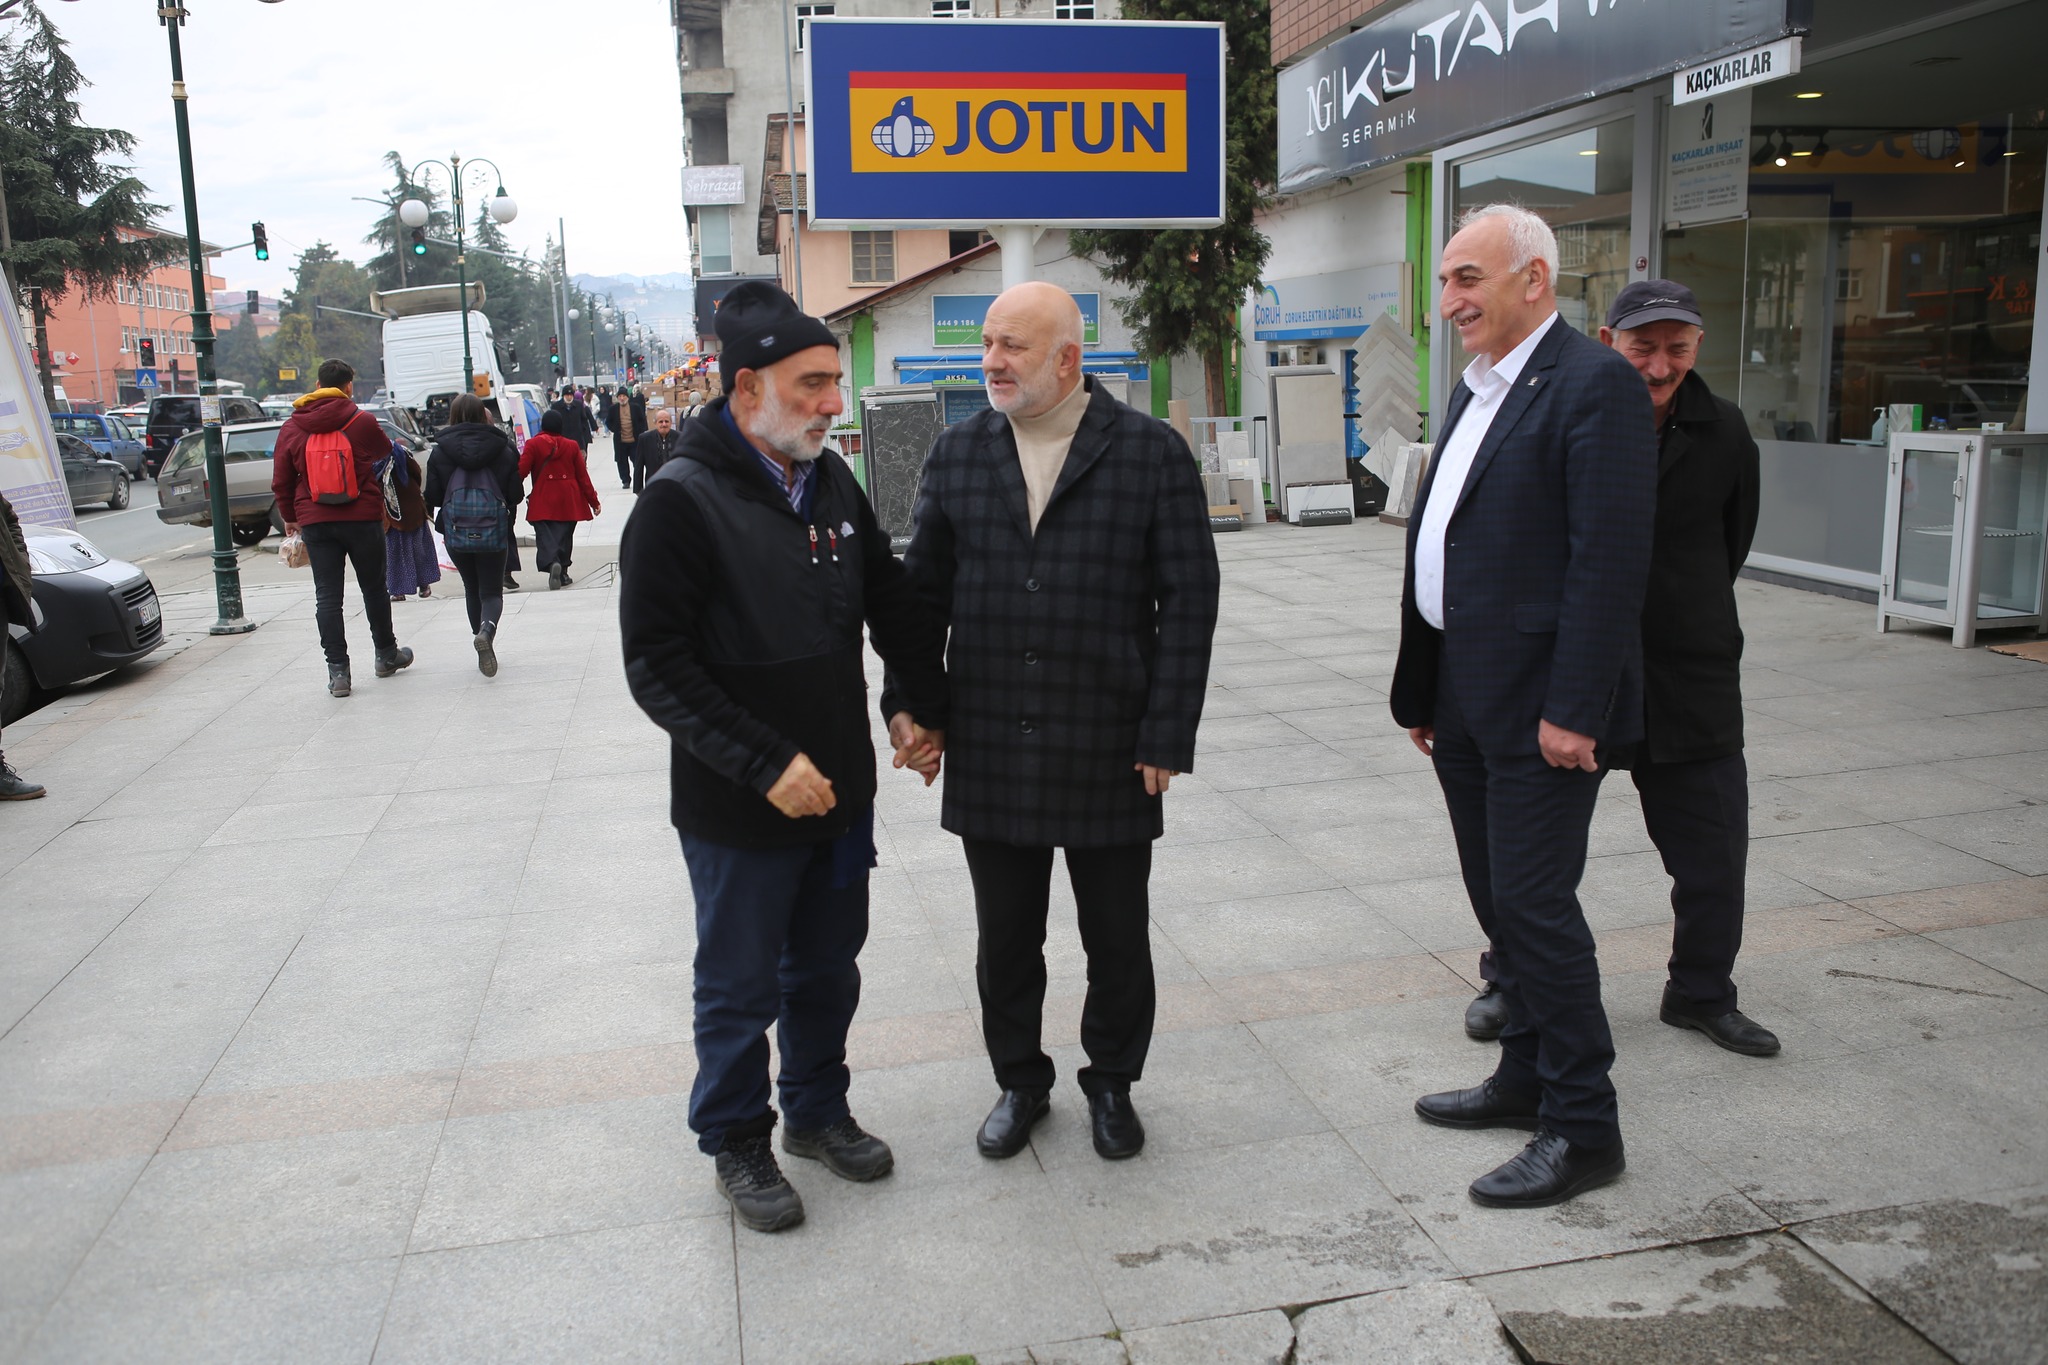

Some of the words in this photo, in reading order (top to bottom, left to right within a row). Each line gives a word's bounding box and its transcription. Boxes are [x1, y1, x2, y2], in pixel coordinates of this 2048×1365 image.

[1342, 0, 1646, 120] KÜTAH
[1686, 51, 1771, 96] KAÇKARLAR
[942, 99, 1166, 156] JOTUN
[1672, 145, 1715, 163] KAÇKARLAR
[1716, 139, 1744, 154] İNŞAAT
[1254, 304, 1281, 327] ÇORUH
[1285, 310, 1302, 327] ÇORUH
[1302, 306, 1328, 323] ELEKTRİK
[1328, 305, 1352, 321] DAĞITIM
